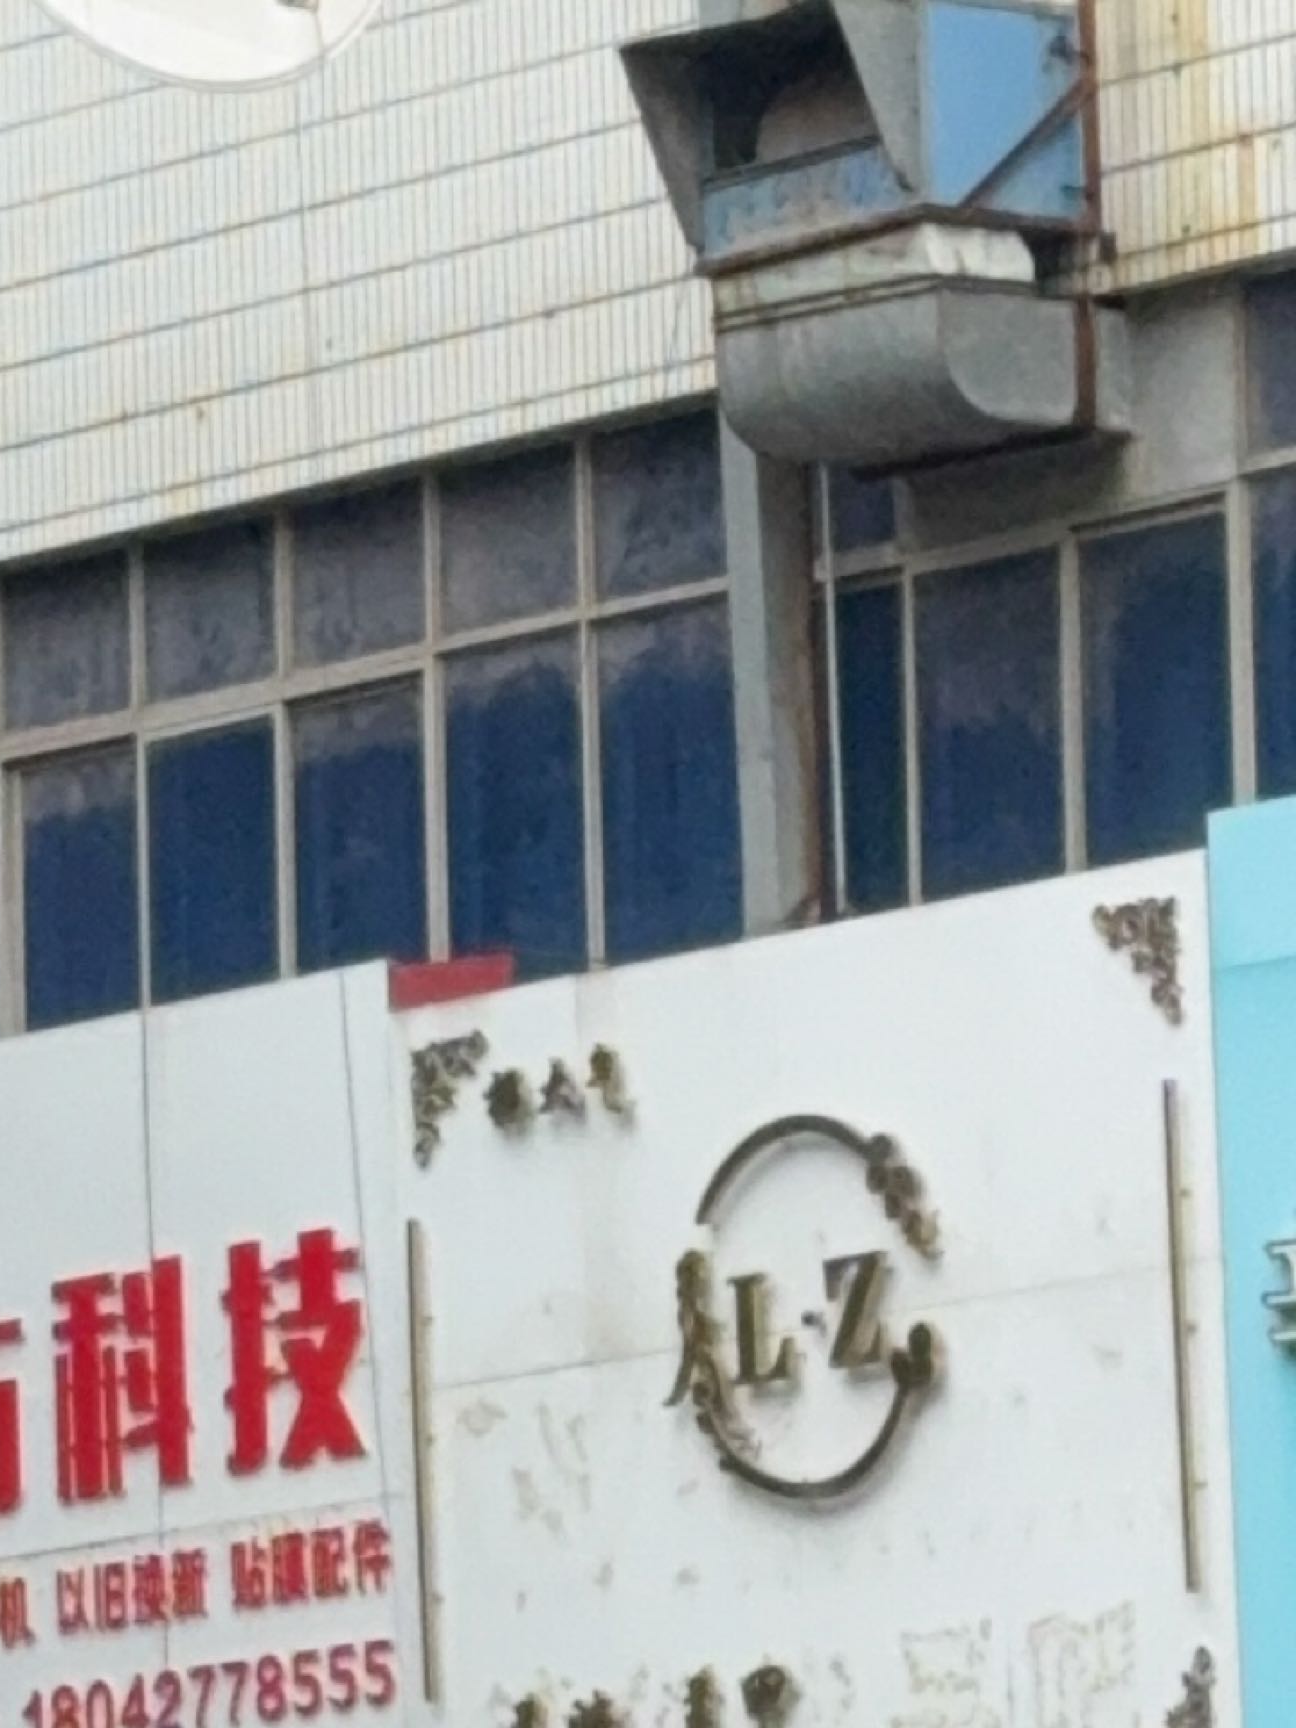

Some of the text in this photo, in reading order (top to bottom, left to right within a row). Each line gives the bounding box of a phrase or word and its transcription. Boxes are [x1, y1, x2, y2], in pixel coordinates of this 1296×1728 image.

[55, 1549, 208, 1636] 以旧换新
[230, 1518, 392, 1613] 贴膜配件
